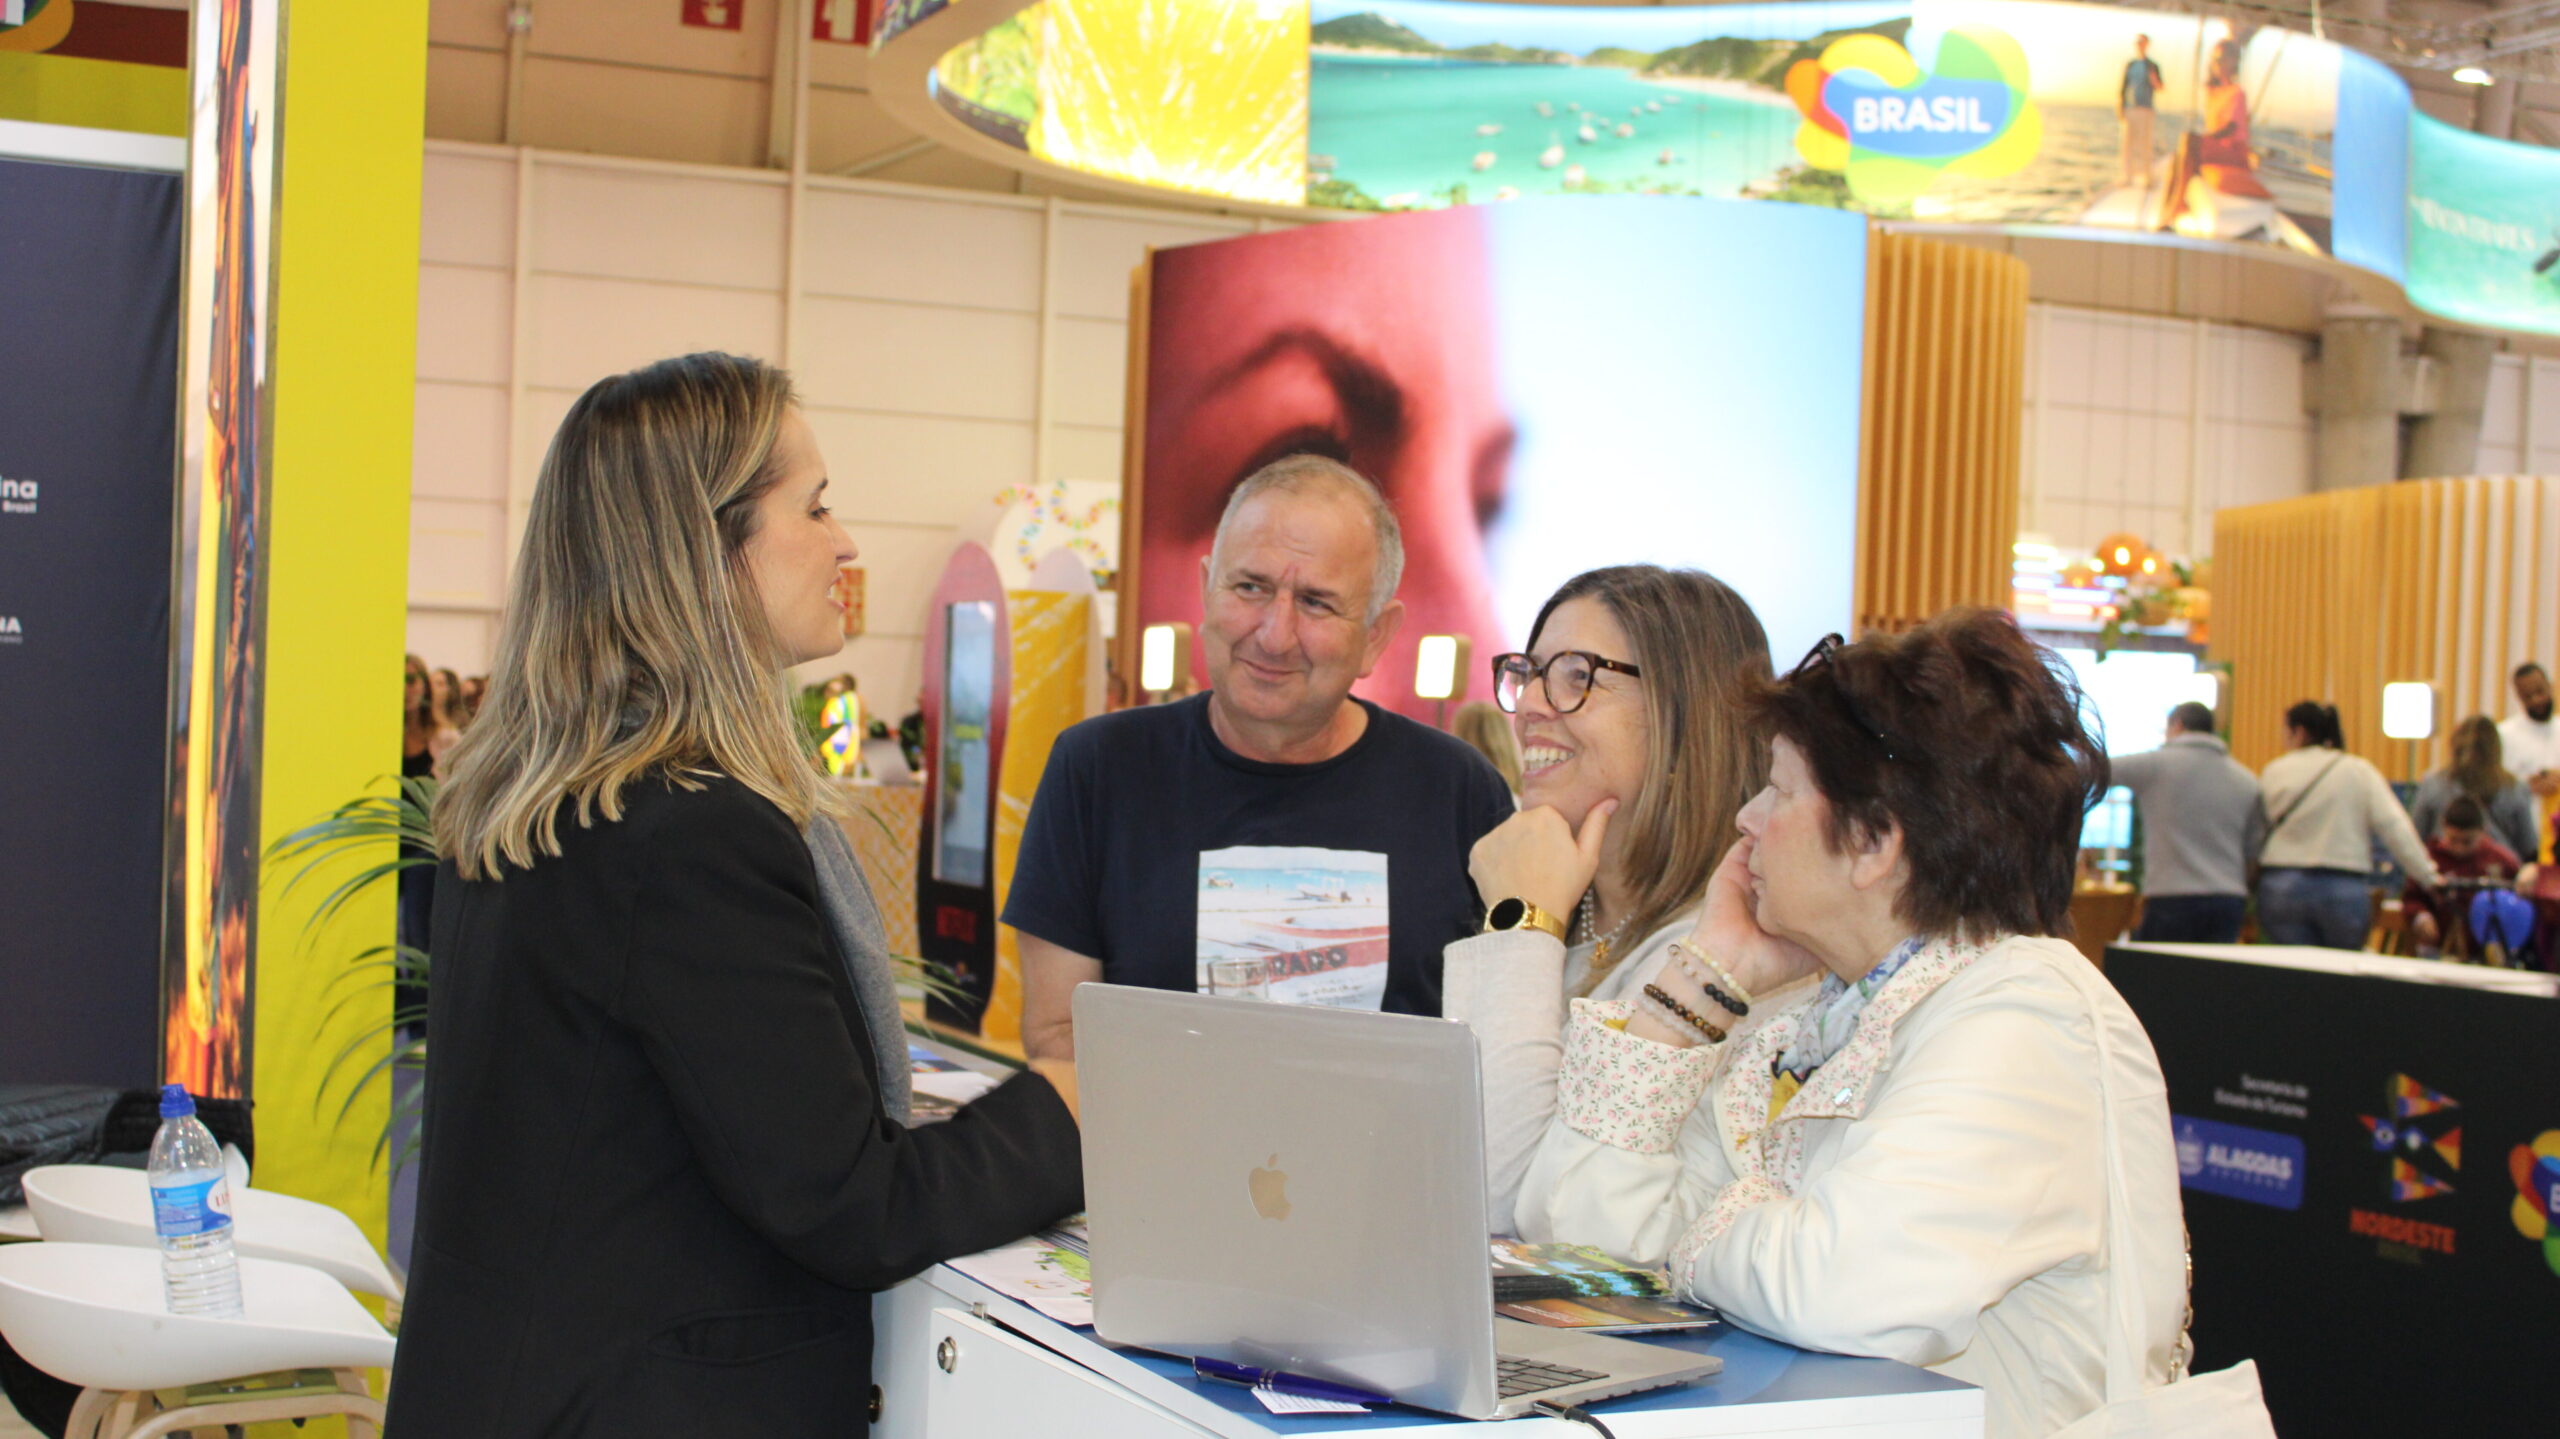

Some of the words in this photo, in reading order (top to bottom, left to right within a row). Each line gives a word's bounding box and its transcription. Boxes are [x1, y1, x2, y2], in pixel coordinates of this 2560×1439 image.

[1854, 96, 1991, 133] BRASIL
[2206, 1143, 2292, 1180] ALAGOAS
[2350, 1208, 2455, 1254] NORDESTE
